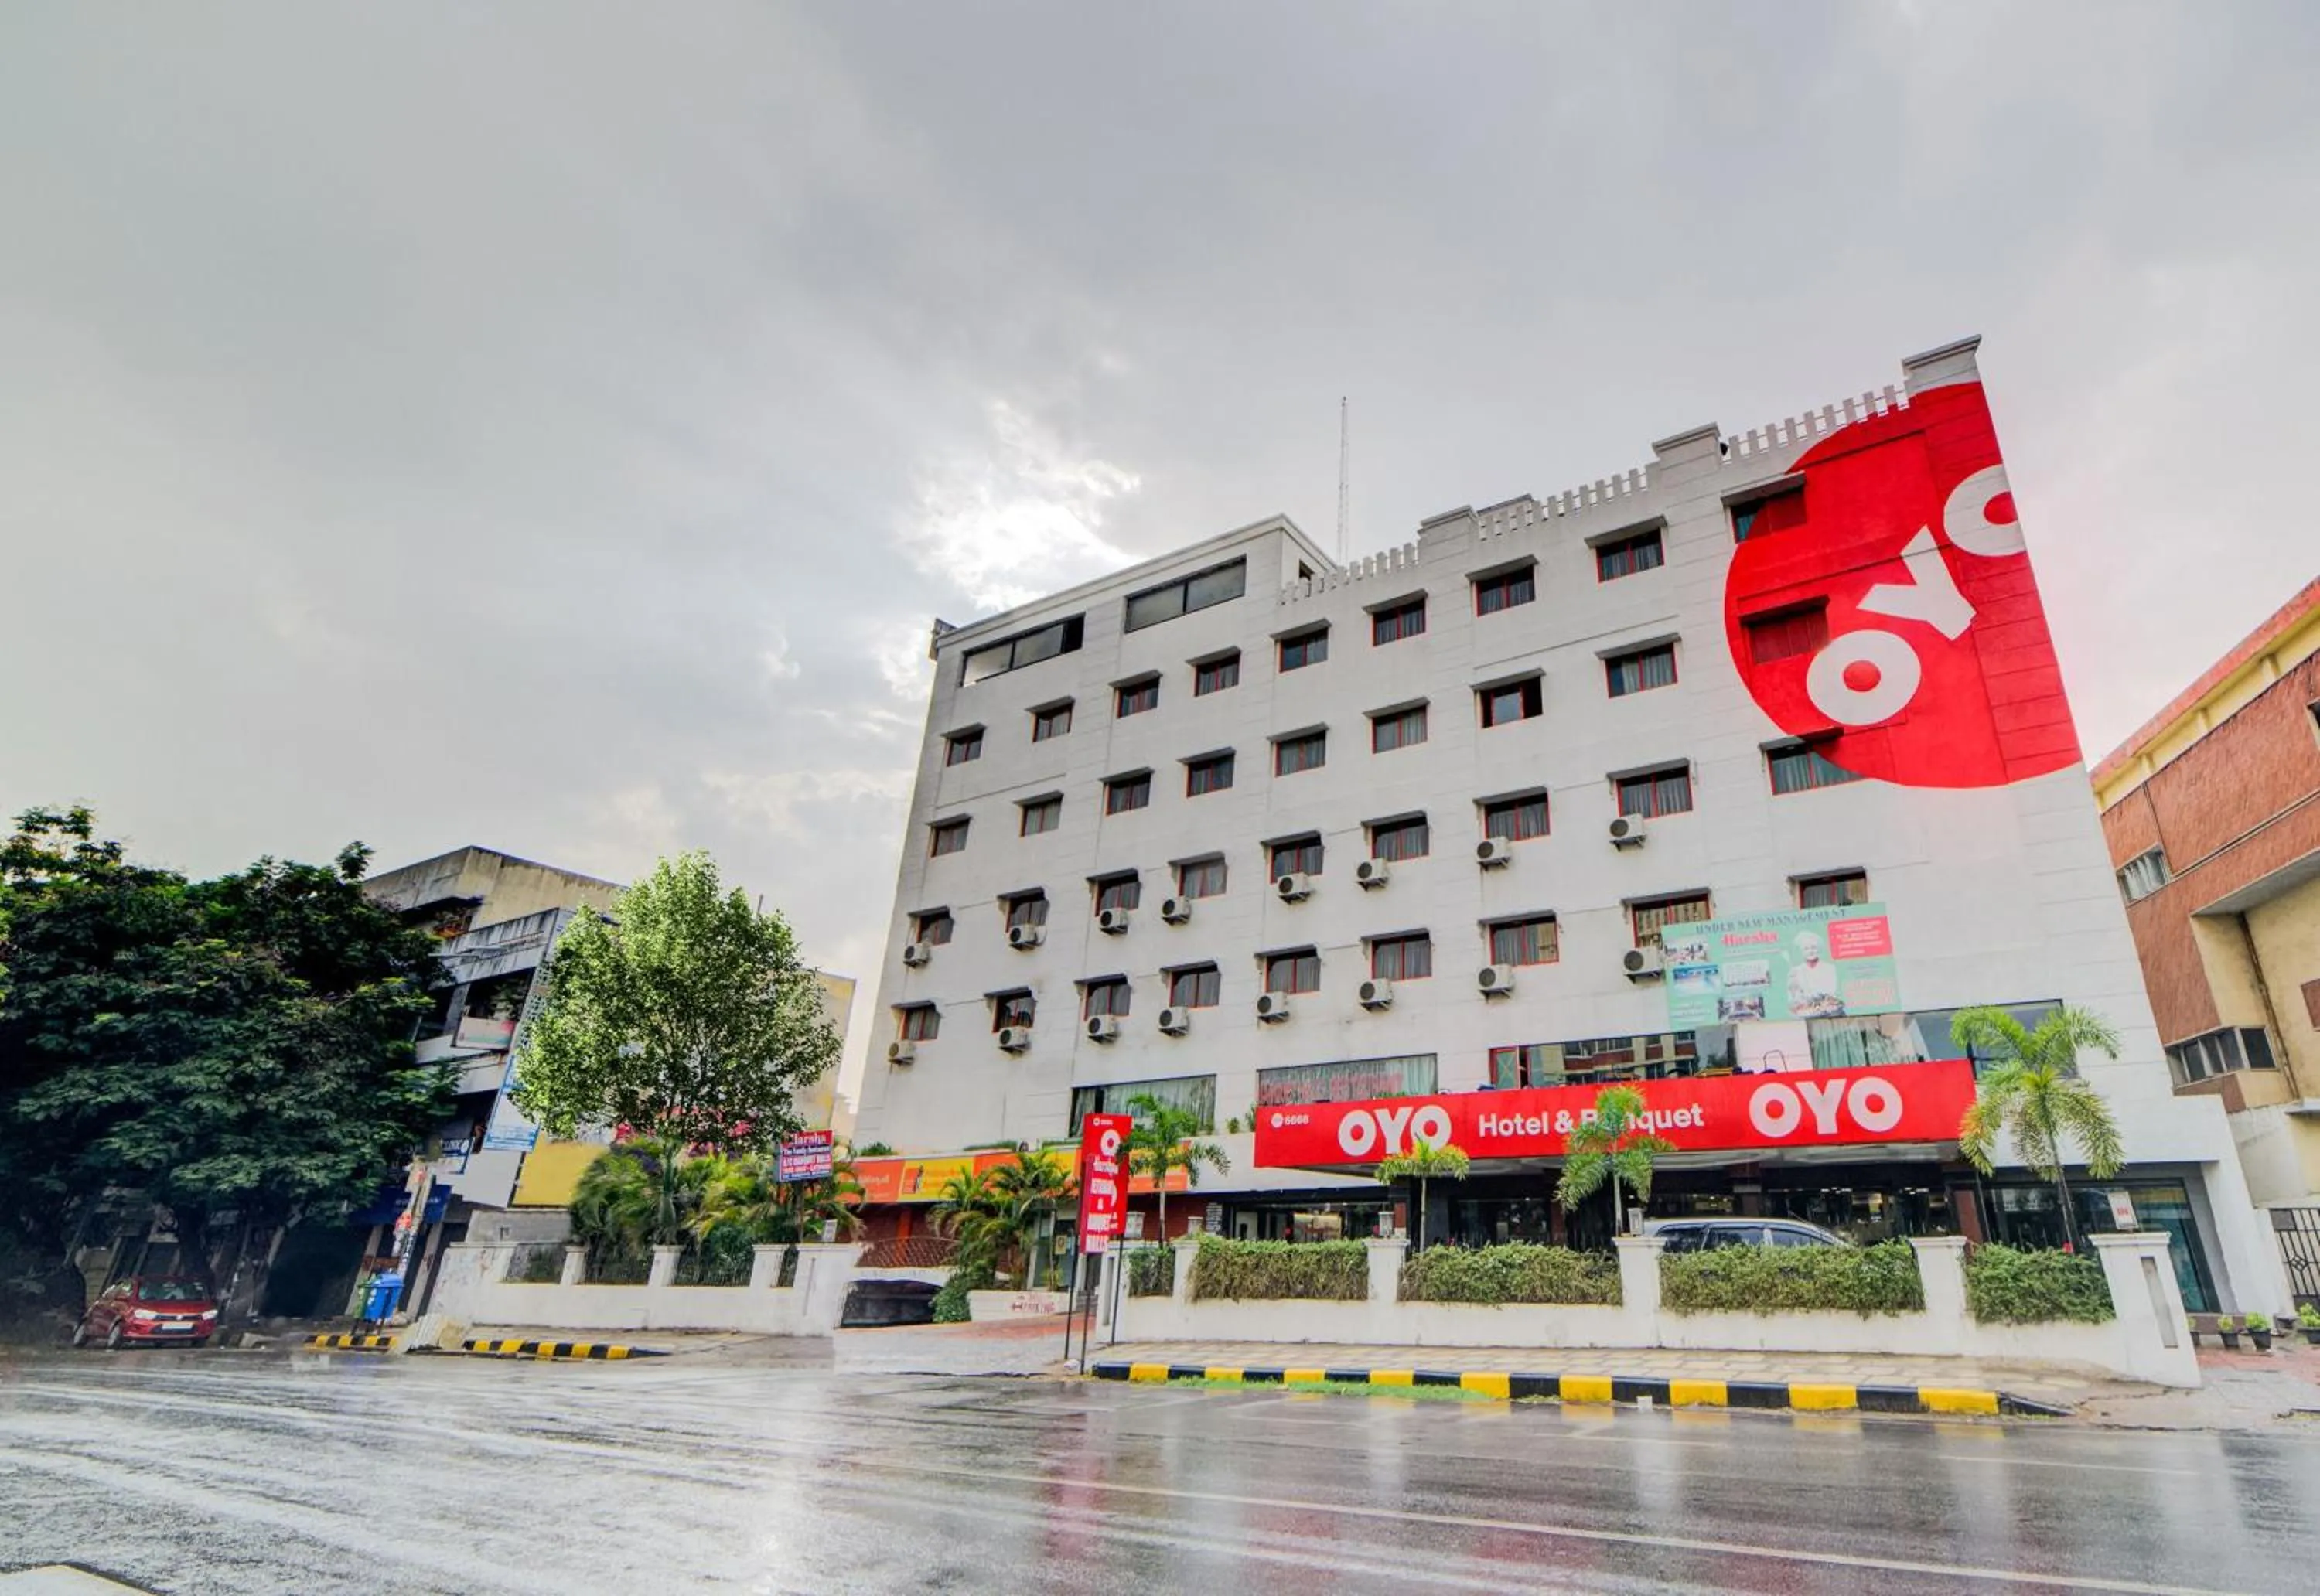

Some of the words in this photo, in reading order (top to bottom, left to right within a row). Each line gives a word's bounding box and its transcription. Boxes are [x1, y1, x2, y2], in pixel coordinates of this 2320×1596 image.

[1807, 463, 2028, 726] OYO
[1696, 922, 1735, 933] UNDER
[1738, 918, 1762, 929] NEW
[1337, 1103, 1452, 1157] OYO
[1479, 1112, 1549, 1137] Hotel
[1554, 1109, 1573, 1134] &
[1581, 1103, 1705, 1134] Bnquet
[1749, 1076, 1903, 1137] OYO
